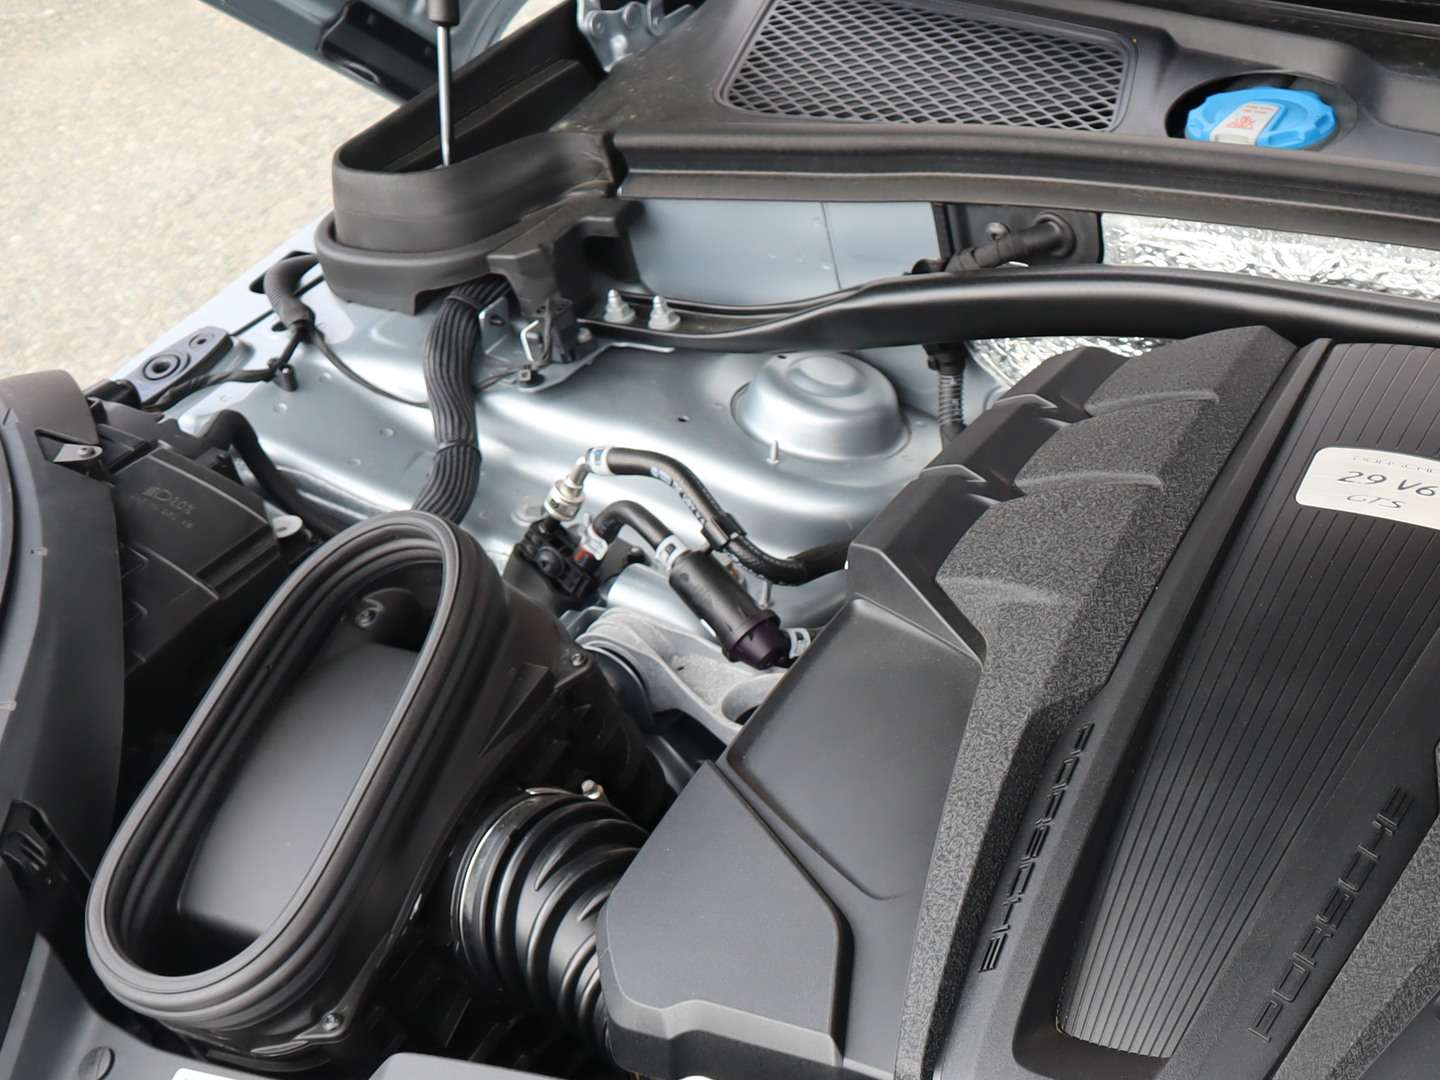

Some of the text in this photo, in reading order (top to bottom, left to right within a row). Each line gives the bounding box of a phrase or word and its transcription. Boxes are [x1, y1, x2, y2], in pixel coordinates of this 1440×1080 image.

[1346, 494, 1406, 509] GTS
[1397, 479, 1439, 497] V6
[978, 722, 1094, 973] PORSCHE
[1248, 786, 1414, 1043] PORSCHE
